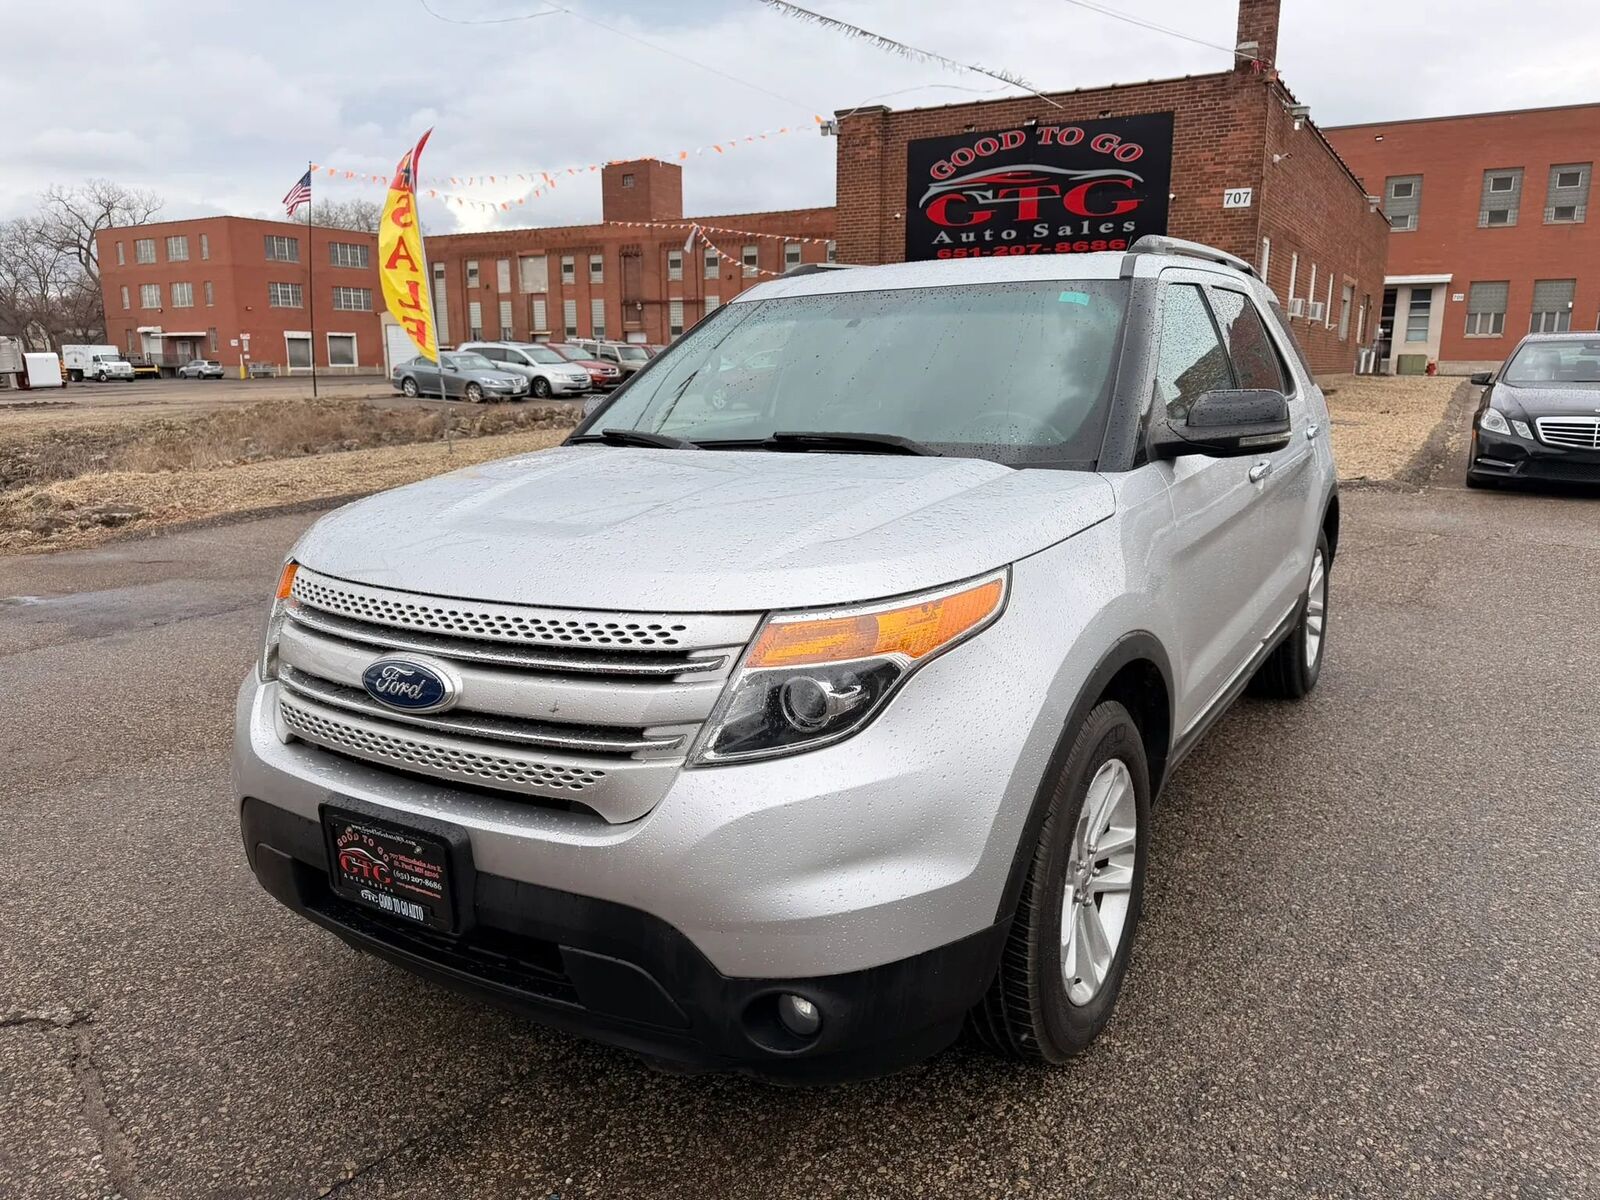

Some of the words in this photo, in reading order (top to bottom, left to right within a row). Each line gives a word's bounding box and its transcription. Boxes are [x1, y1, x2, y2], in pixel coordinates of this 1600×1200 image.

[930, 130, 1026, 180] GOOD
[1036, 126, 1084, 146] TO
[1091, 133, 1144, 162] GO
[926, 178, 1144, 227] GTG
[1224, 191, 1251, 205] 707
[931, 228, 1018, 245] Auto
[1033, 219, 1137, 239] Sales
[936, 238, 1127, 259] 651-207-8686
[375, 665, 426, 700] Ford
[337, 833, 360, 847] GOOD
[362, 835, 375, 847] TO
[393, 869, 410, 882] (651)
[410, 875, 442, 891] 207-8686
[379, 893, 393, 910] GOOD
[408, 903, 424, 922] AUTO
